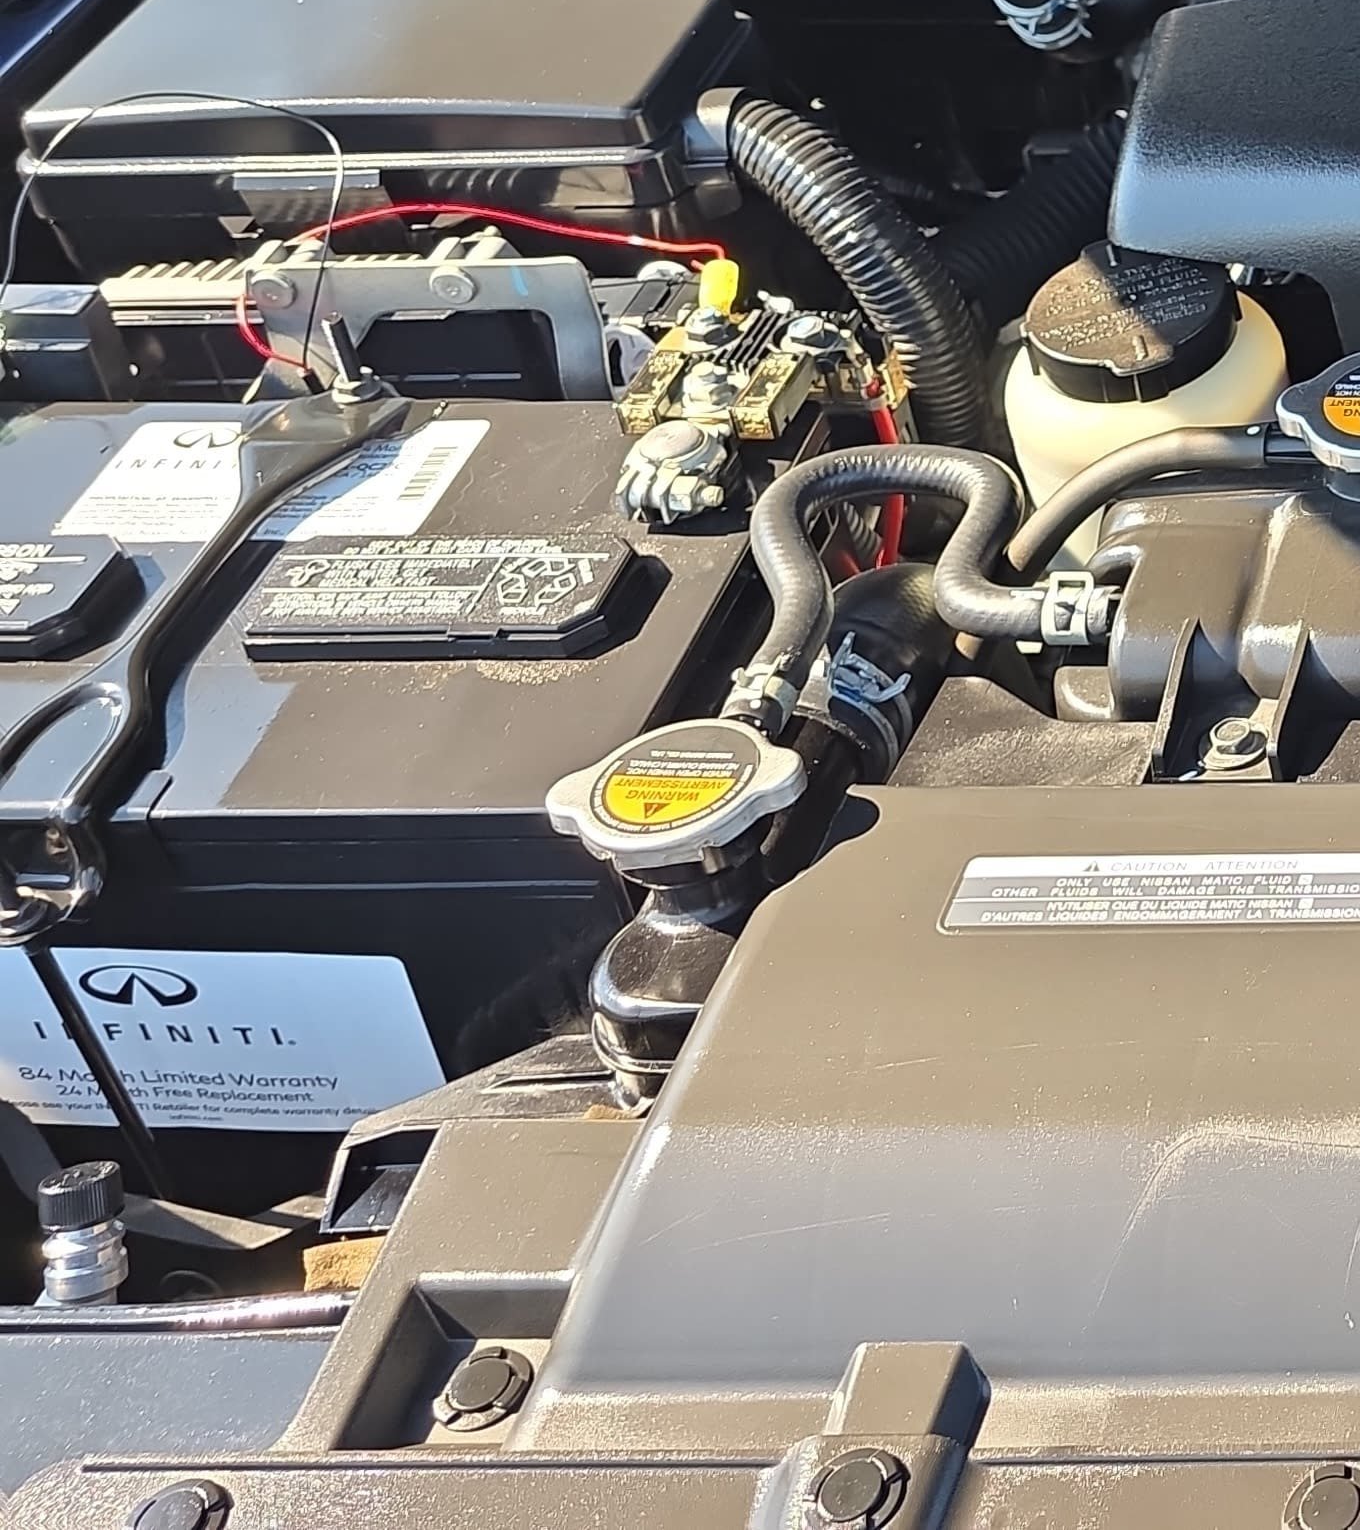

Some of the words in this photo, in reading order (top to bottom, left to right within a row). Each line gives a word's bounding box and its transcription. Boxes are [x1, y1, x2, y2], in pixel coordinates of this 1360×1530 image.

[115, 458, 237, 469] INFINI
[330, 560, 370, 569] FLUSH
[370, 560, 401, 569] EYES
[403, 559, 481, 568] IMMEDIATELY
[319, 579, 367, 588] MEDICAL
[370, 578, 403, 587] HELP
[614, 778, 727, 790] AVERTISSEMENT
[625, 790, 700, 801] WARNING
[1110, 861, 1188, 872] CAUTION
[1204, 860, 1298, 871] ATTENTION
[1056, 877, 1094, 886] ONLY
[1102, 877, 1131, 886] USE
[1140, 877, 1191, 886] NISSAN
[1201, 876, 1243, 885] MATIC
[1253, 875, 1291, 885] FLUID
[991, 888, 1040, 897] OTHER
[1050, 887, 1099, 896] FLUIDS
[1112, 887, 1144, 896] WILL
[1157, 886, 1216, 895] DAMAGE
[1229, 885, 1256, 895] THE
[1112, 901, 1138, 911] QUE
[1140, 900, 1158, 910] DU
[1160, 900, 1208, 910] LIQUIDE
[1209, 900, 1246, 909] MATIC
[1248, 899, 1293, 909] NISSAN
[981, 912, 1043, 922] D'AUTRES
[1049, 911, 1109, 920] LIQUIDES
[1113, 909, 1242, 920] ENDOMMAGERAIENT
[1246, 909, 1263, 919] LA
[19, 1067, 53, 1081] 84
[59, 1068, 135, 1084] Moh
[141, 1070, 225, 1086] Limited
[228, 1073, 338, 1090] Warranty
[56, 1084, 82, 1096] 24
[87, 1084, 149, 1098] Mth
[153, 1086, 192, 1099] Free
[197, 1087, 315, 1102] Replacement
[202, 1104, 220, 1113] for
[224, 1106, 280, 1116] complete
[284, 1107, 340, 1117] warranty
